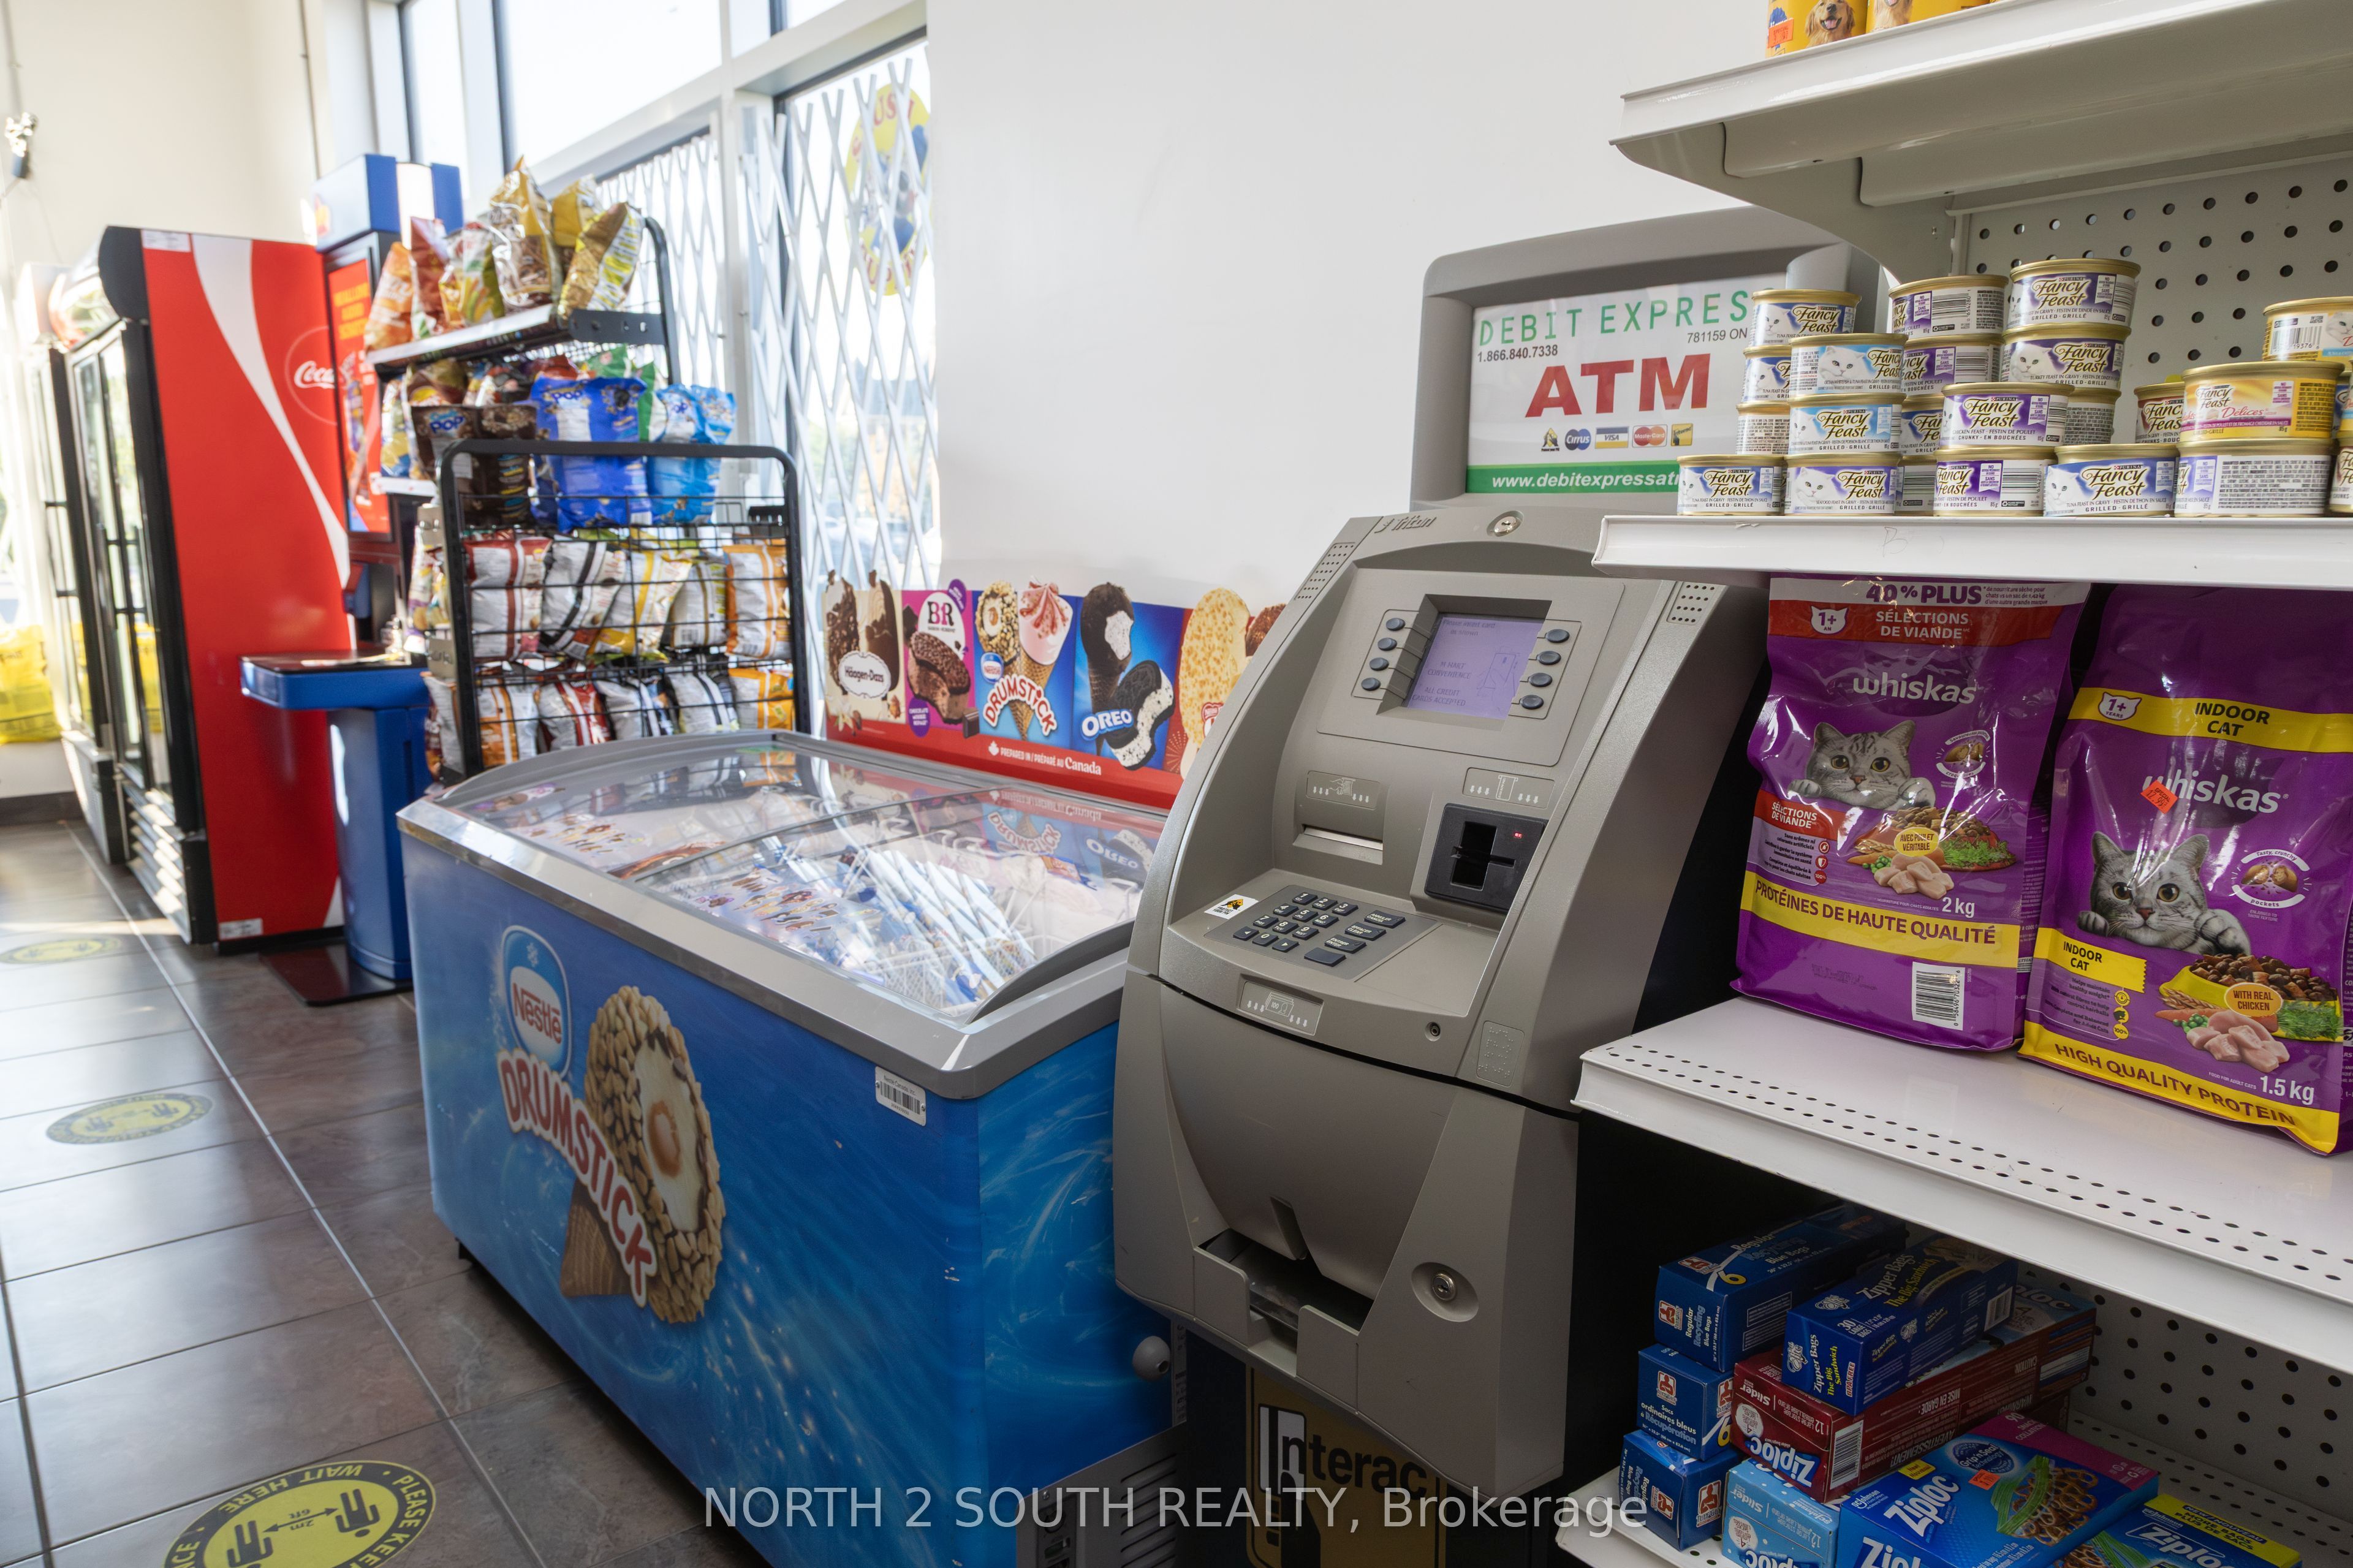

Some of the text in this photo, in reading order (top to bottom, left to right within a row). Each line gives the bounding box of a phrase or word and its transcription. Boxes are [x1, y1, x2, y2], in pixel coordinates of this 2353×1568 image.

[2032, 278, 2090, 297] Fancy
[2037, 293, 2086, 309] Feast
[1479, 288, 1775, 346] DEBIT EXPRES
[1792, 306, 1840, 323] Fancy
[1687, 328, 1747, 343] 781159 ON
[1798, 320, 1837, 333] Feast
[1478, 344, 1558, 362] 1.866.840.7338
[2055, 344, 2110, 362] Fancy
[2063, 358, 2107, 374] Feast
[1525, 354, 1710, 417] ATM
[1964, 398, 2022, 414] Fancy
[1817, 411, 1870, 428] Fancy
[1969, 413, 2018, 429] Feast
[1566, 434, 1590, 444] Cirrus
[1824, 424, 1868, 440] Feast
[1704, 470, 1753, 485] Fancy
[1838, 471, 1887, 488] Fancy
[2082, 468, 2147, 487] Fancy
[1711, 483, 1751, 498] Feast
[1843, 485, 1884, 500] Feast
[2092, 482, 2145, 500] Feast
[1866, 584, 1980, 605] 40 % PLUS
[928, 601, 954, 626] BR
[1819, 612, 1837, 625] 1+
[1876, 609, 1969, 625] SÉLECTIONS
[1881, 626, 1962, 639] DE VIANDE
[1853, 673, 1977, 704] whiskas
[2109, 699, 2126, 712] 1+
[2196, 702, 2270, 725] INDOOR
[1082, 711, 1132, 736] OREO
[2207, 720, 2244, 736] CAT
[1001, 748, 1025, 759] PREPARED
[1065, 757, 1101, 775] Canada
[2155, 787, 2170, 802] SPECIAL
[1772, 801, 1817, 820] SÉLECTIONS
[1772, 811, 1811, 828] DE VIANDE
[1900, 834, 1915, 843] AVEC
[1903, 840, 1930, 851] VÉRITABLE
[2275, 850, 2297, 861] crunchy
[1756, 879, 1996, 944] PROTÉINES DE HAUTE QUALITÉ
[1942, 897, 1975, 918] 2 kg
[2251, 899, 2279, 907] pockets
[2063, 941, 2102, 963] INDOOR
[2071, 958, 2090, 971] CAT
[2234, 990, 2273, 1001] WITH REAL
[512, 982, 561, 1043] Nestlé
[2238, 1001, 2270, 1011] CHICKEN
[2055, 1043, 2296, 1127] HIGH QUALITY PROTEIN
[2260, 1076, 2314, 1105] 1.5 kg
[502, 1059, 652, 1295] DRUMSTICK
[1730, 1232, 1775, 1251] Regular
[1718, 1270, 1747, 1285] 6
[1694, 1305, 1705, 1347] Recycling
[1837, 1320, 1855, 1330] 30
[1810, 1335, 1824, 1393] Zipper Bags
[1830, 1346, 1841, 1385] Sandwich
[1740, 1384, 1771, 1406] Slider
[1641, 1402, 1697, 1435] ordinaires bleus
[1661, 1404, 1673, 1415] Sacs
[1645, 1411, 1697, 1445] Récupération
[1815, 1419, 1824, 1434] 12
[1268, 1406, 1428, 1501] Interac
[1750, 1436, 1815, 1488] Ziploc
[219, 1465, 363, 1514] WAIT HERE
[392, 1474, 426, 1528] PLEASE
[1730, 1489, 1764, 1513] Slider
[1884, 1475, 1960, 1537] Ziploc
[2216, 1518, 2264, 1542] NOUVEAU
[2139, 1526, 2235, 1568] Ziplo
